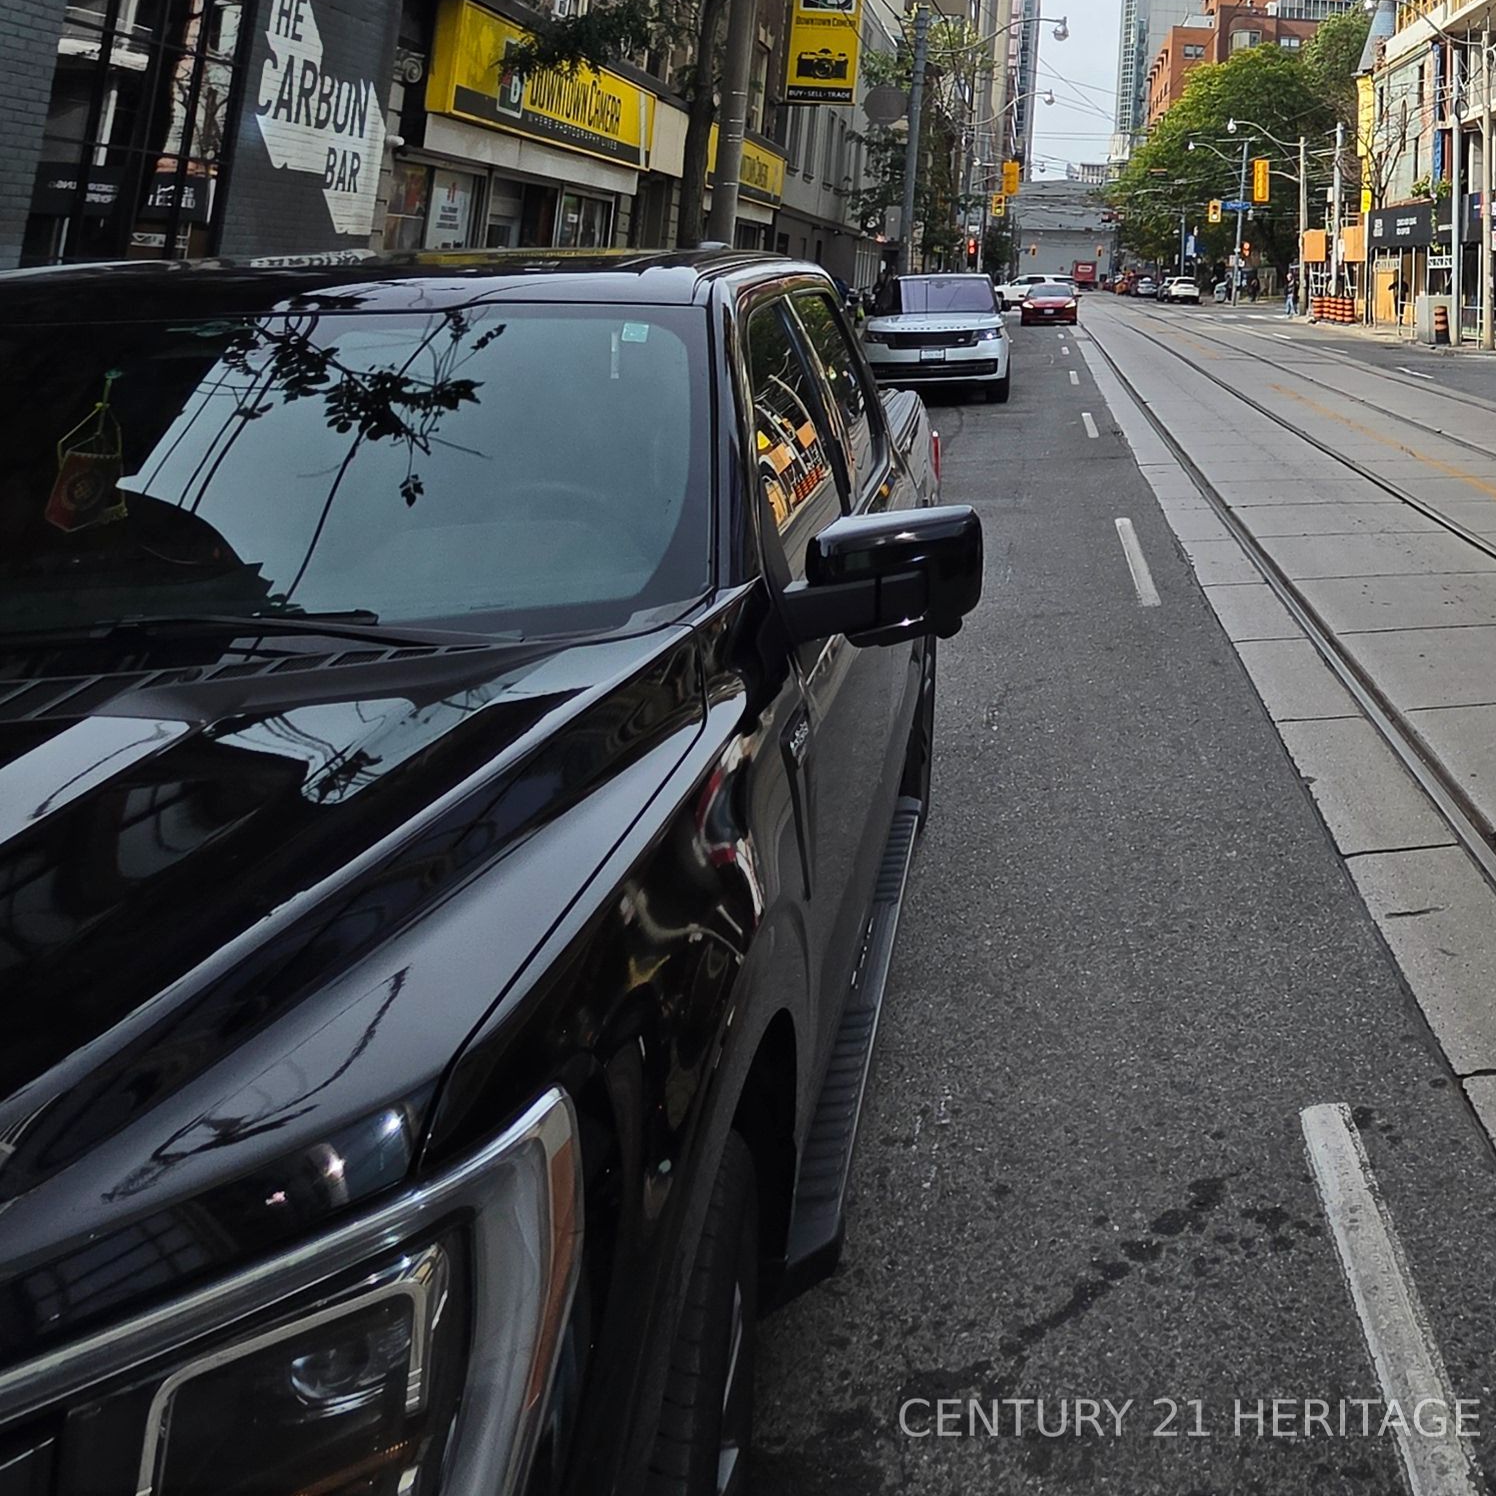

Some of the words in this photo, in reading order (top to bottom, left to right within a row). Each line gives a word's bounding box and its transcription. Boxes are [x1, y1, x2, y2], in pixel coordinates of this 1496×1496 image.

[796, 16, 831, 26] DOWNTOWN
[255, 54, 370, 138] CARBON
[529, 66, 591, 125] DOWNTOWN
[325, 146, 361, 194] BAR
